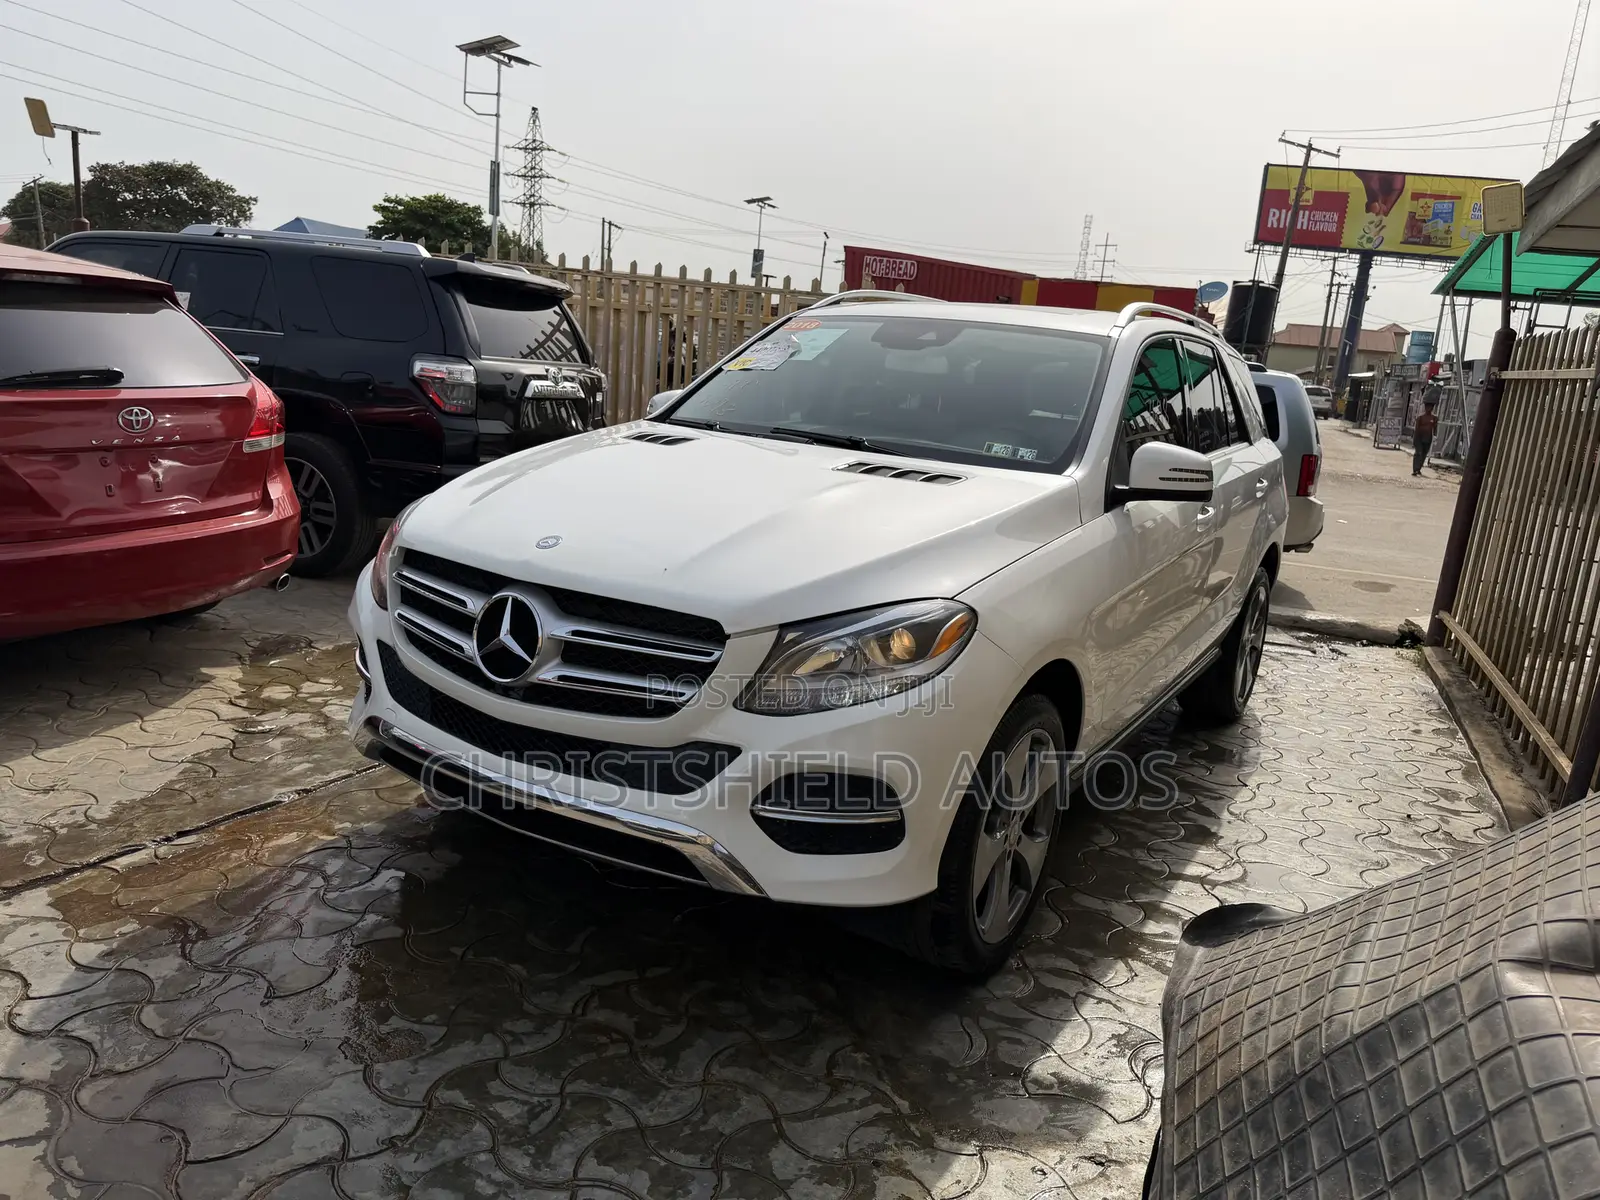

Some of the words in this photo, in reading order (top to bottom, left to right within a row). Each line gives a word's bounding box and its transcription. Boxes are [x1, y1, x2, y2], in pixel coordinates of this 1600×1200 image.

[1310, 210, 1340, 222] CHICKEN
[1308, 220, 1337, 232] FLAVOUR
[91, 435, 181, 445] VENZA
